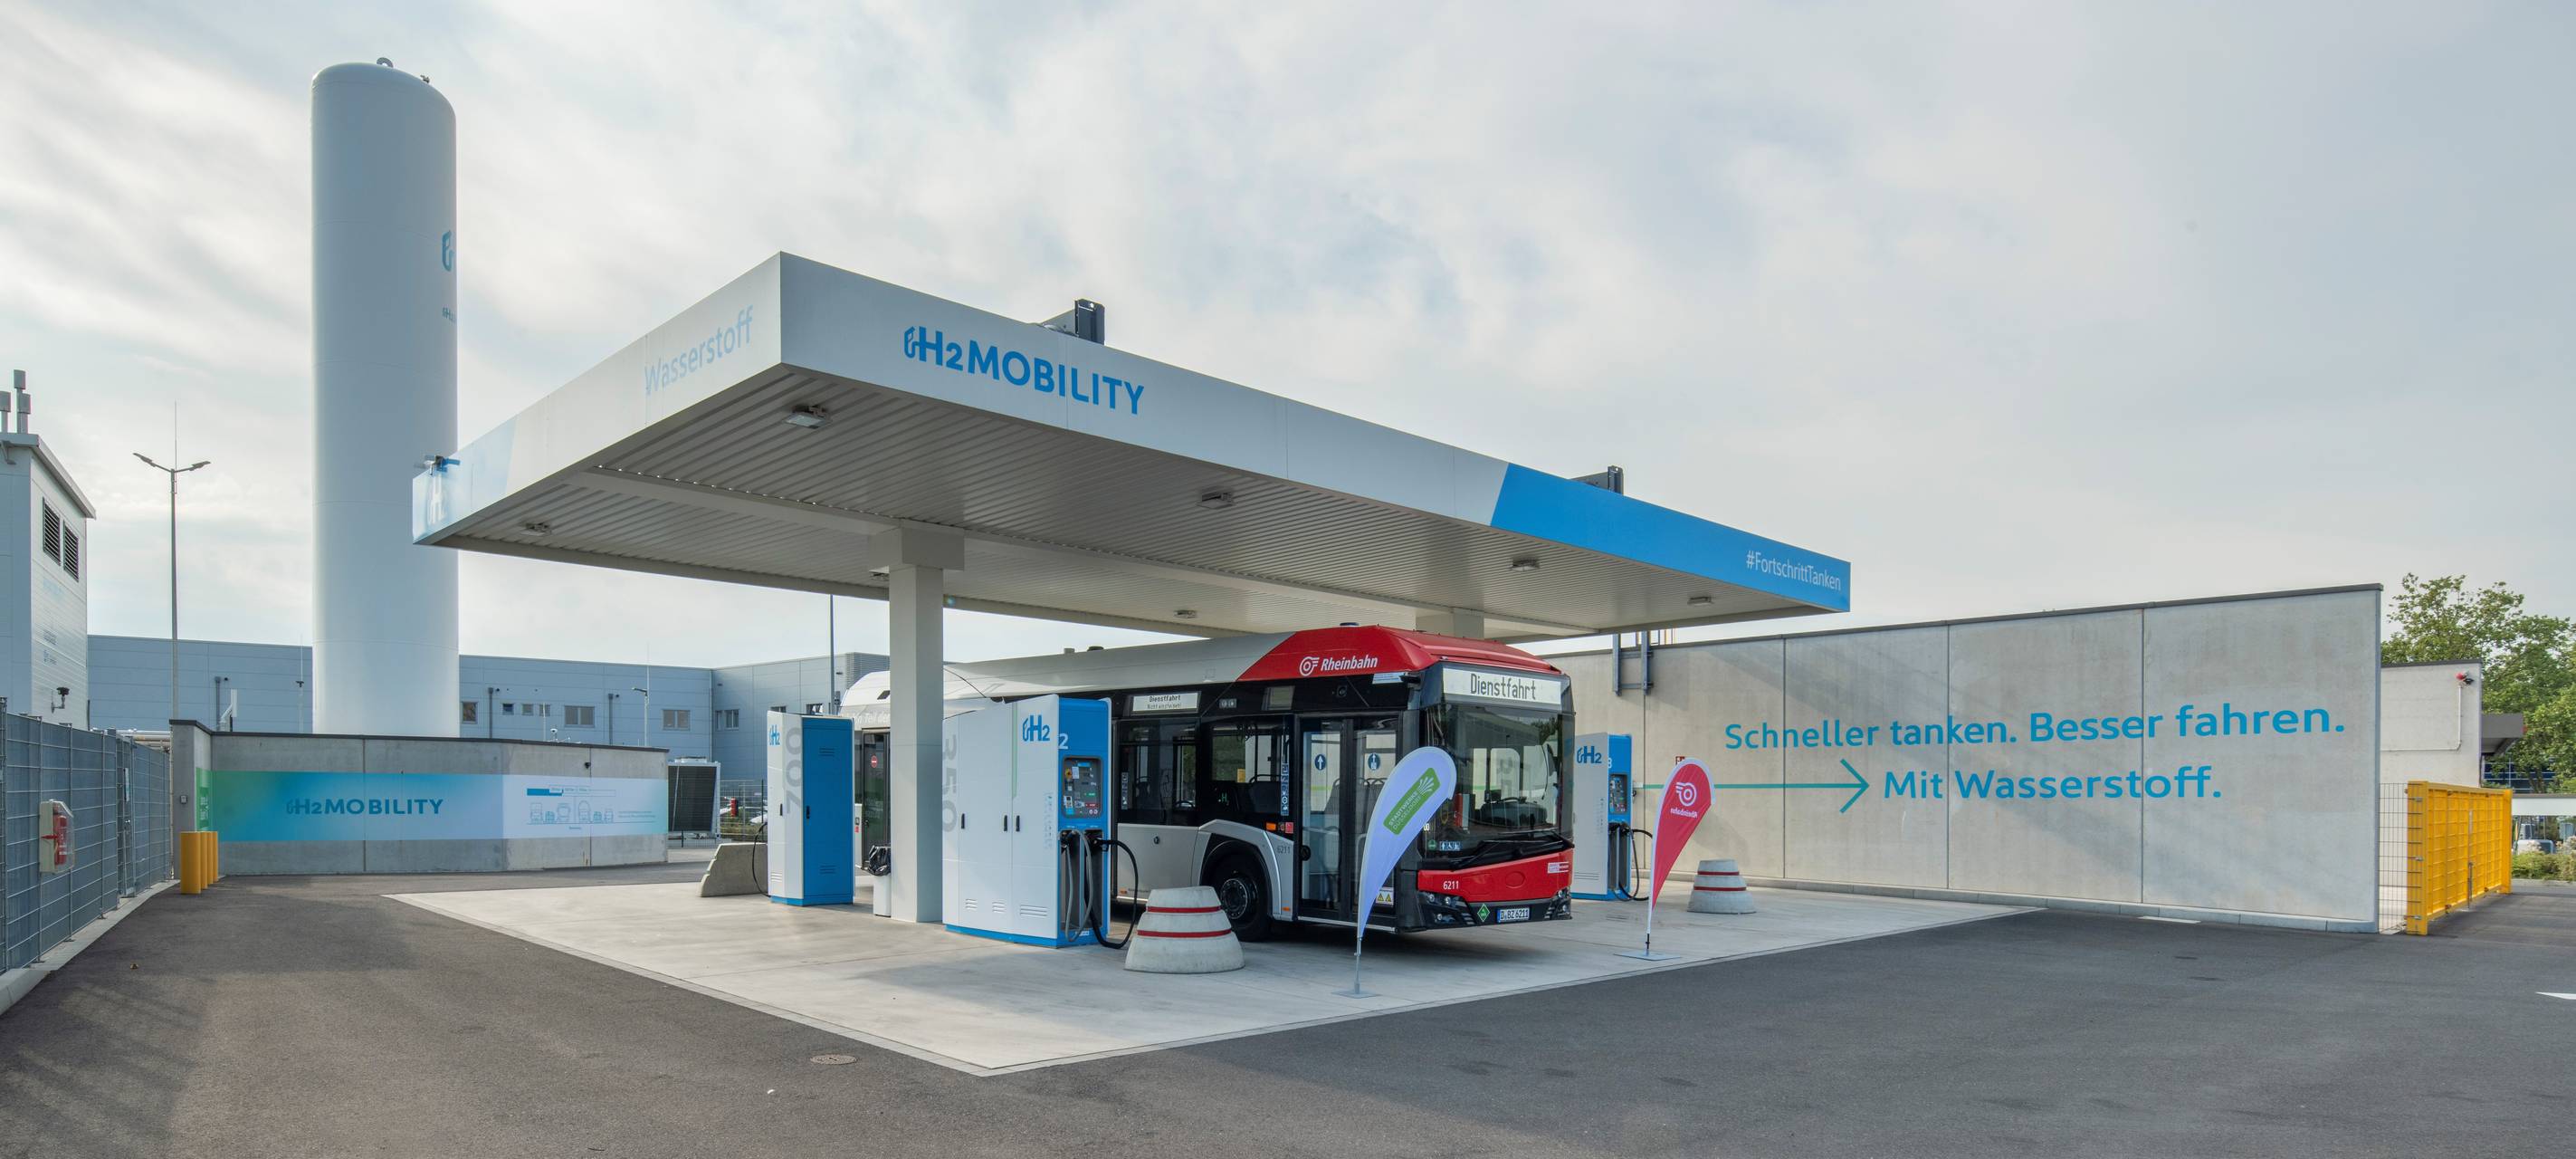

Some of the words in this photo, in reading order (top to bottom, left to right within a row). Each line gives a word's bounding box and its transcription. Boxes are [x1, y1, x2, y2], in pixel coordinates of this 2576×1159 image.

[644, 304, 753, 396] Wasserstoff
[912, 325, 1145, 416] H2MOBILITY
[1746, 550, 1841, 591] #FortschrittTanken
[1321, 655, 1379, 672] Rheinbahn
[1470, 673, 1537, 700] Dienstfahrt
[1026, 714, 1051, 742] H2
[1725, 719, 1880, 750] Schneller
[1890, 714, 2018, 747] tanken.
[2030, 712, 2164, 742] Besser
[2175, 703, 2345, 738] fahren.
[1580, 745, 1602, 764] H2
[785, 727, 802, 814] 700
[1884, 771, 1943, 800] Mit
[1954, 765, 2222, 800] Wasserstoff.
[291, 798, 444, 815] H2MOBILITY
[1443, 880, 1459, 890] 6211
